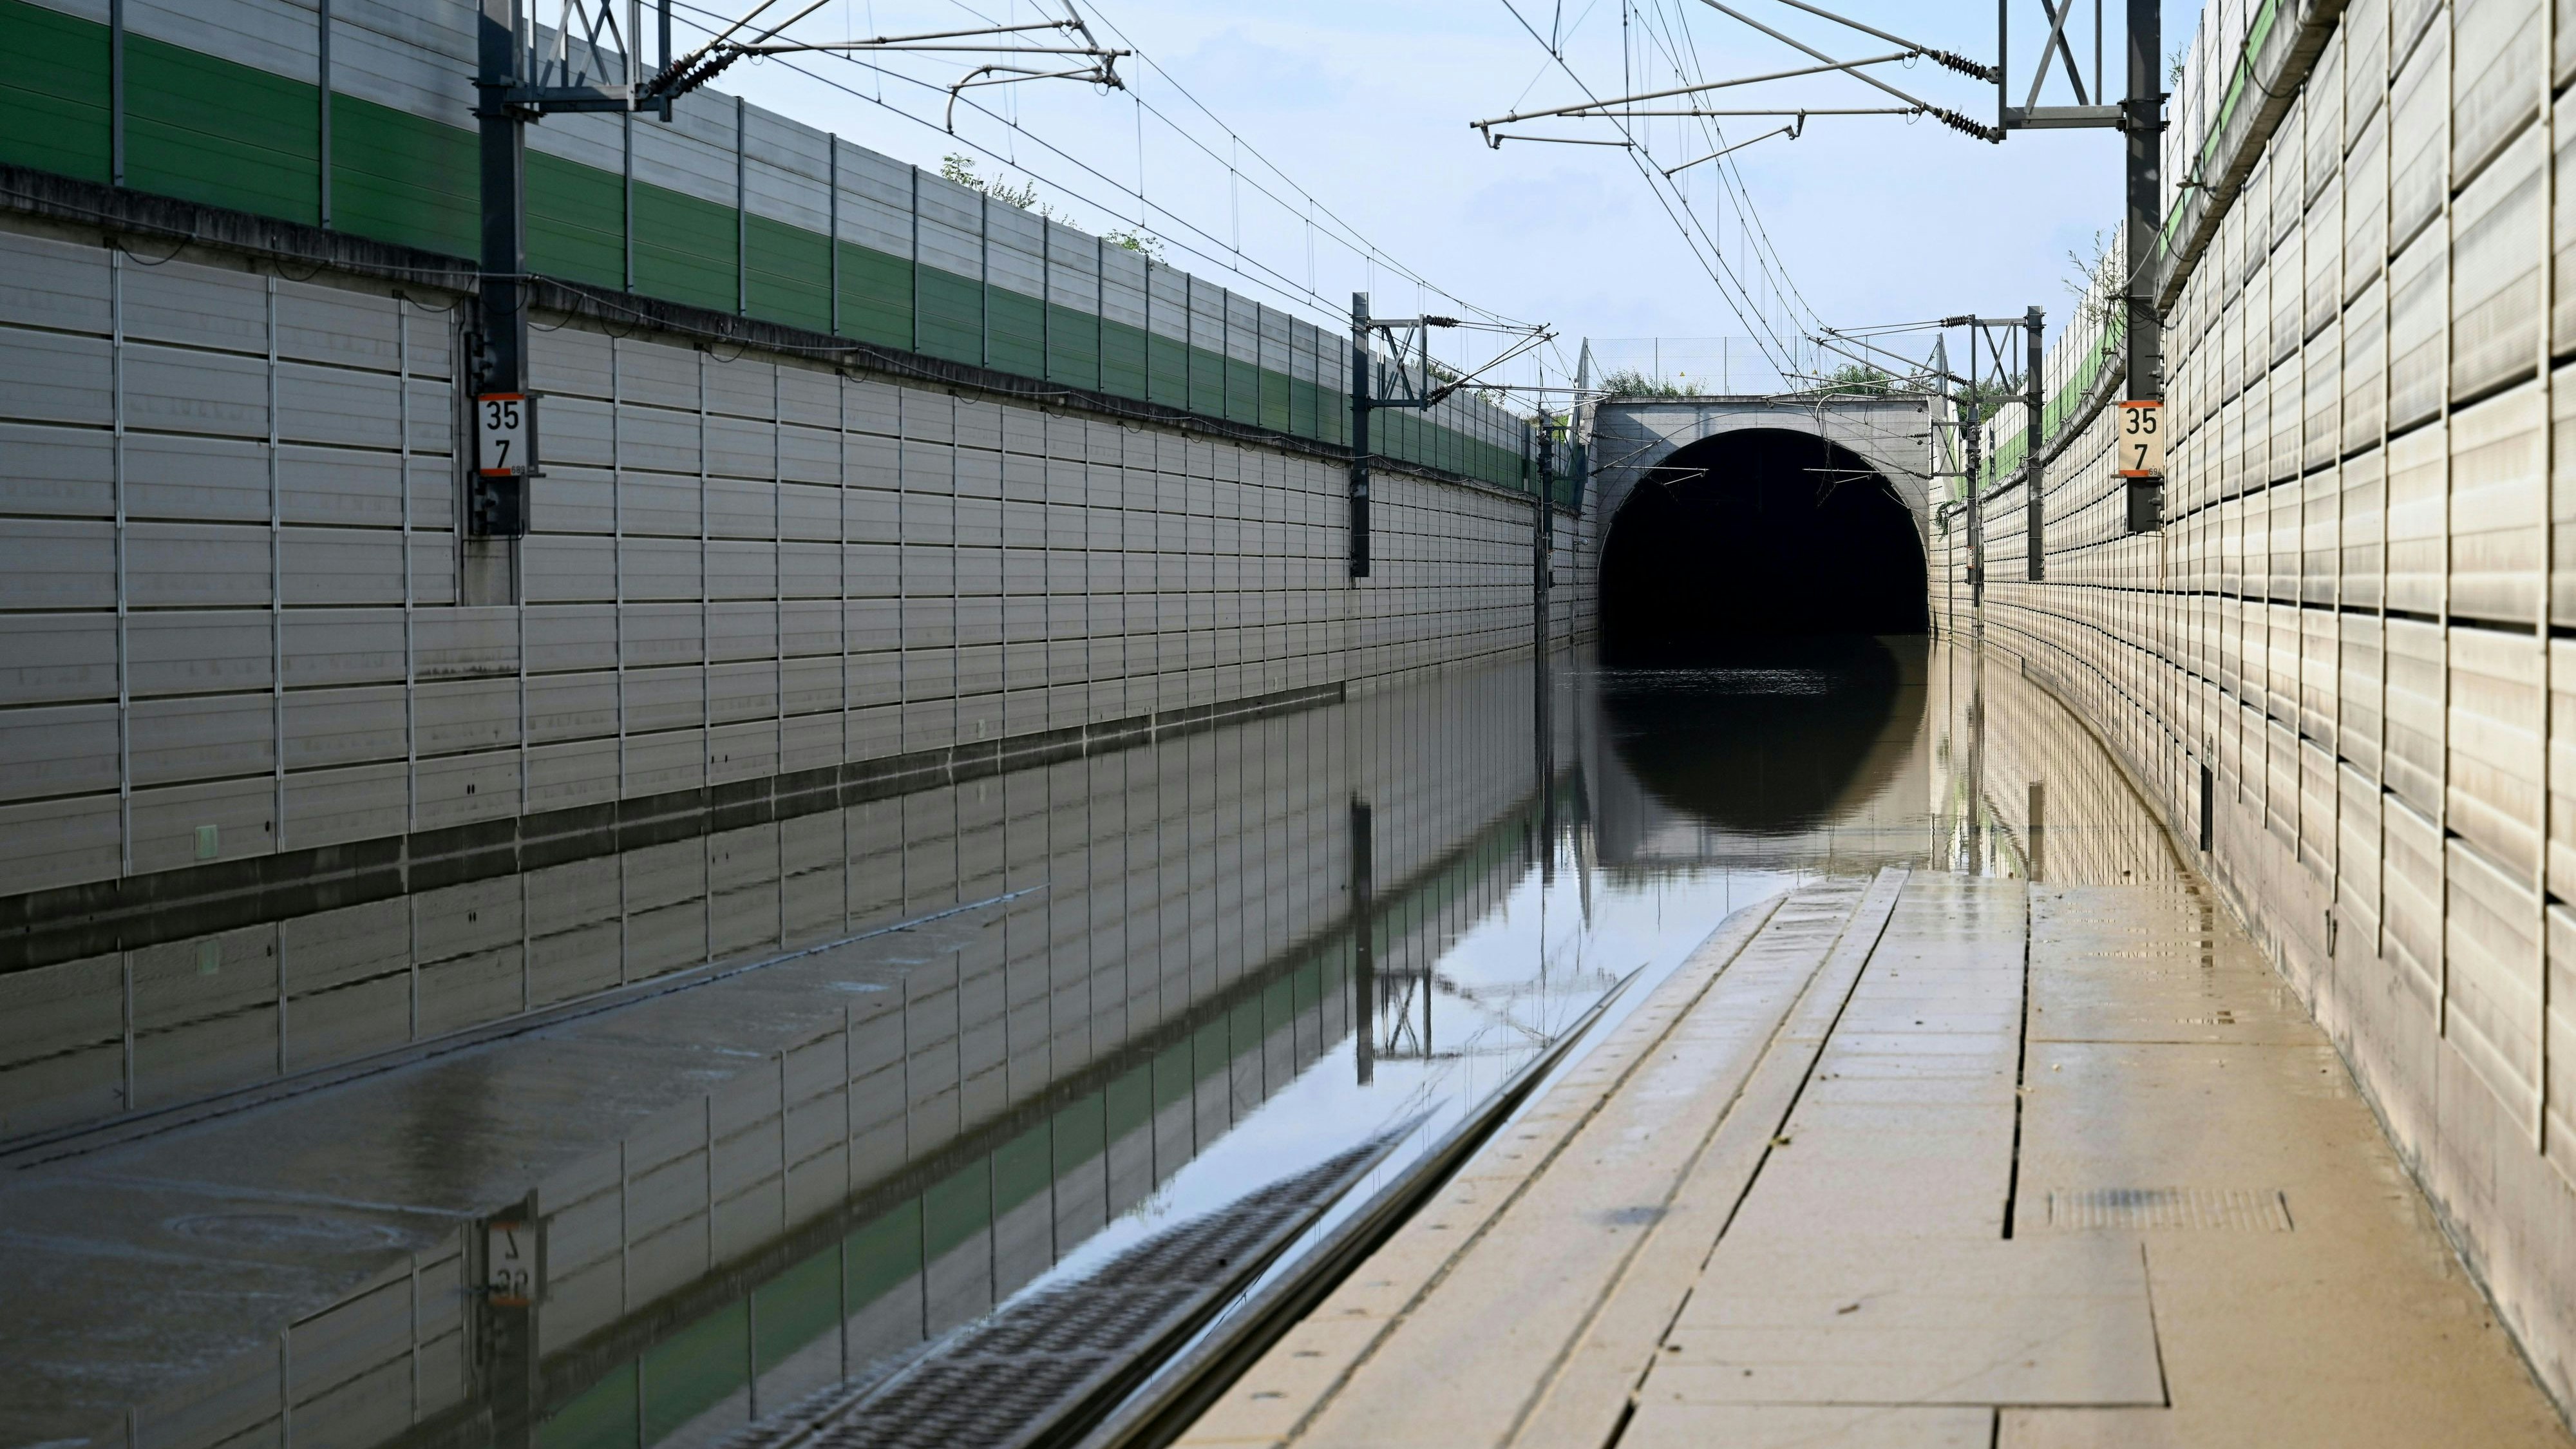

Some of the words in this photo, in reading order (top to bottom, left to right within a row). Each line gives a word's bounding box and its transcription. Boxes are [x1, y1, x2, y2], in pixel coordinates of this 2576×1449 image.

[486, 401, 518, 430] 35
[2126, 408, 2156, 434] 35
[496, 440, 509, 468] 7
[2135, 444, 2148, 469] 7
